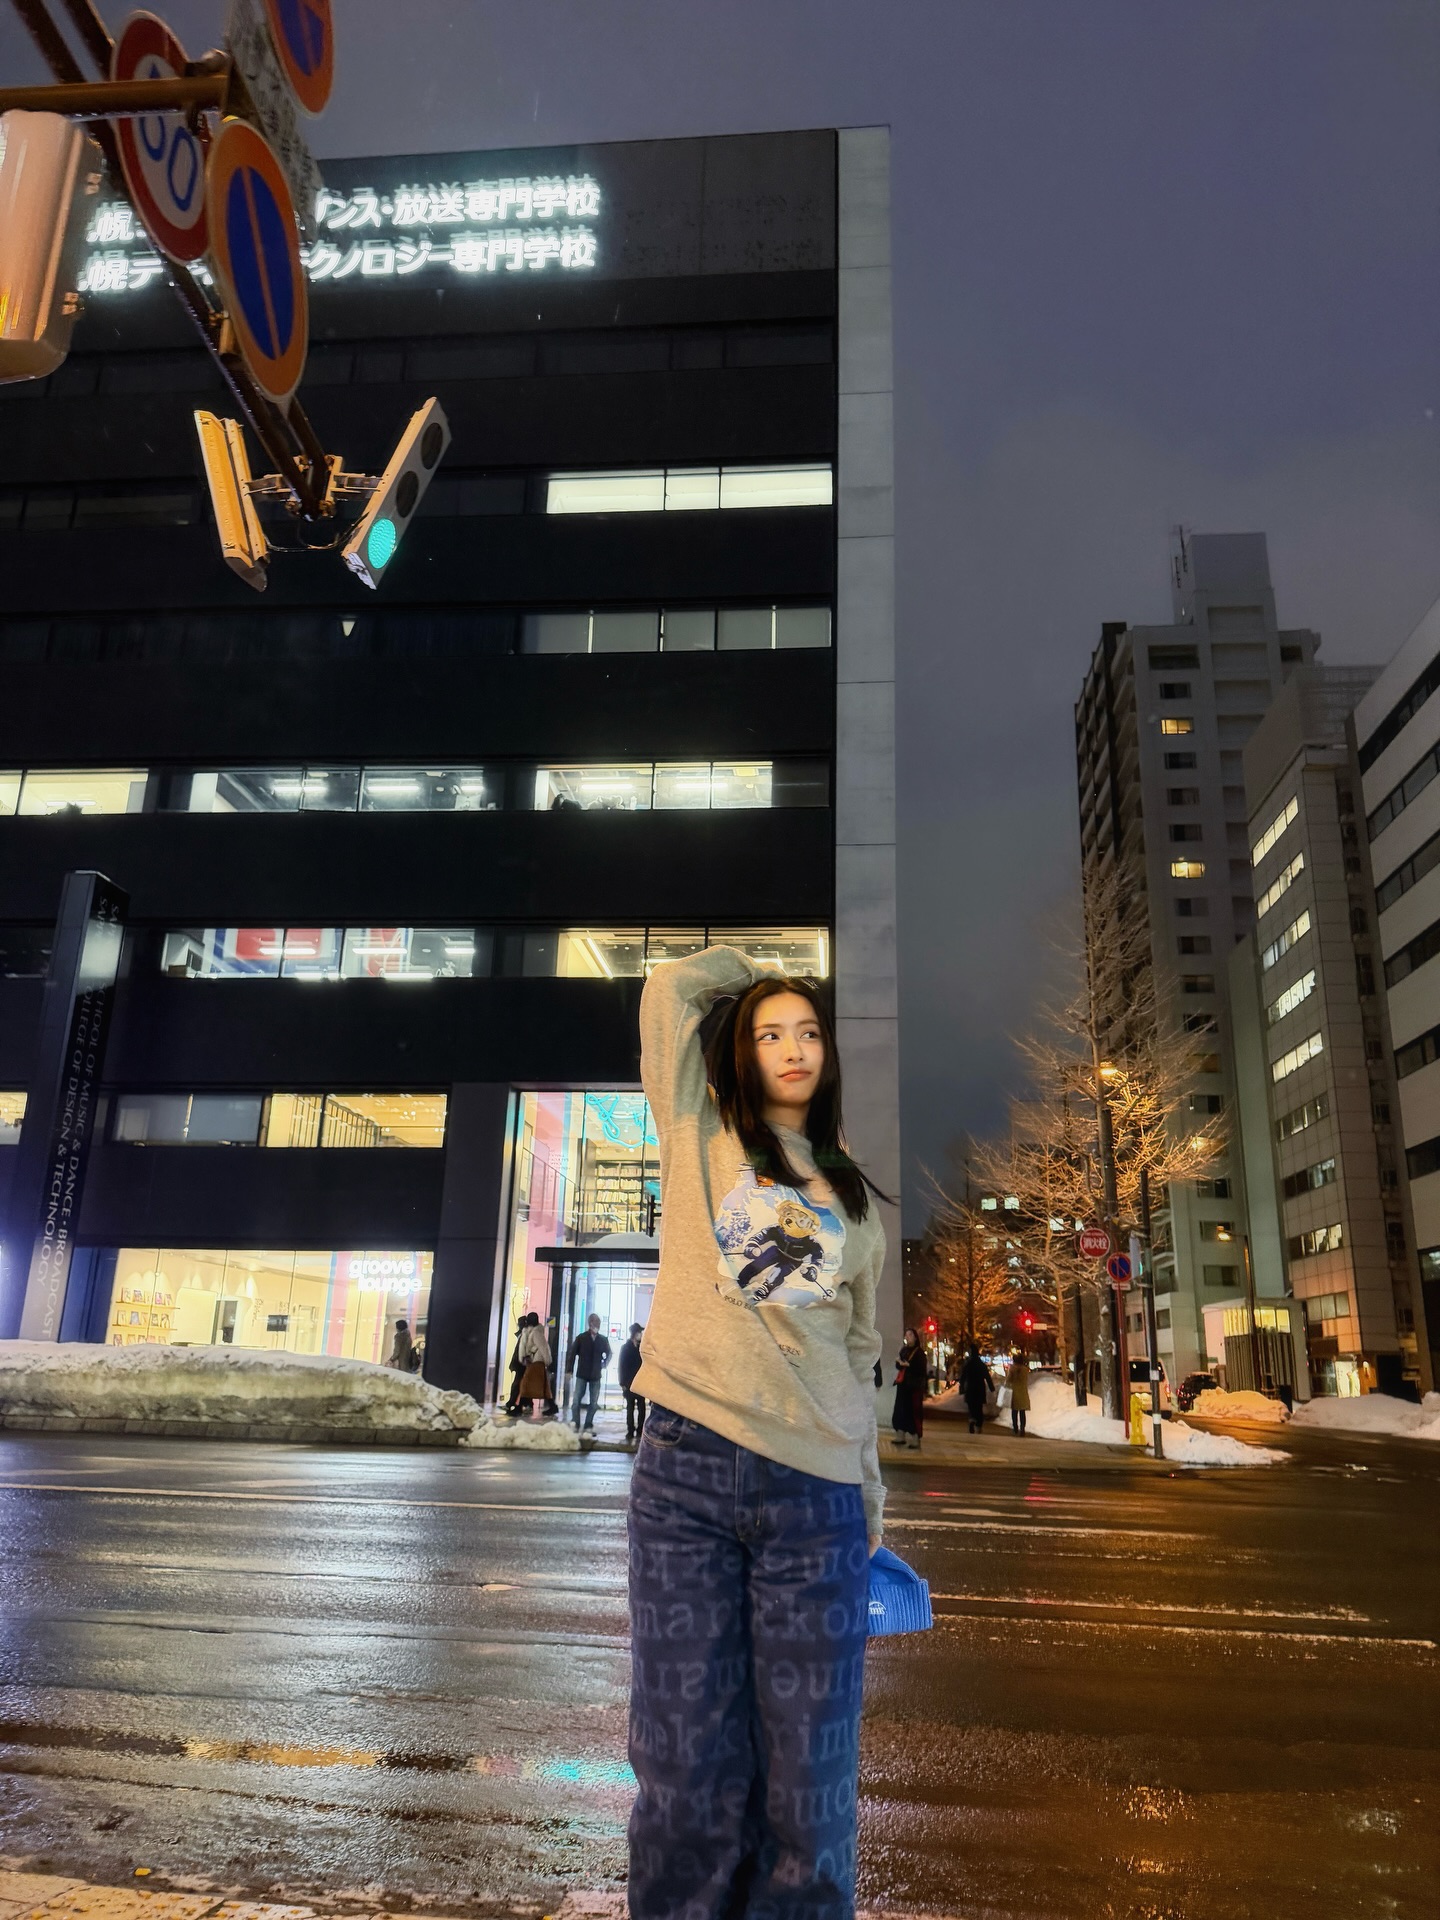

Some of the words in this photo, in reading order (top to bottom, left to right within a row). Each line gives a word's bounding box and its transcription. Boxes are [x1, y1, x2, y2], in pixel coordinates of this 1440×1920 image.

[71, 1050, 83, 1076] OF
[85, 1053, 96, 1078] OF
[60, 1077, 79, 1140] DESIGN
[74, 1079, 92, 1136] MUSIC
[57, 1144, 67, 1156] &
[72, 1138, 82, 1151] &
[36, 1162, 65, 1287] TECHNOLOGY
[1083, 1237, 1108, 1249] 消火栓
[348, 1259, 414, 1279] groove
[42, 1229, 68, 1338] BROADCAST
[358, 1276, 422, 1297] lounge
